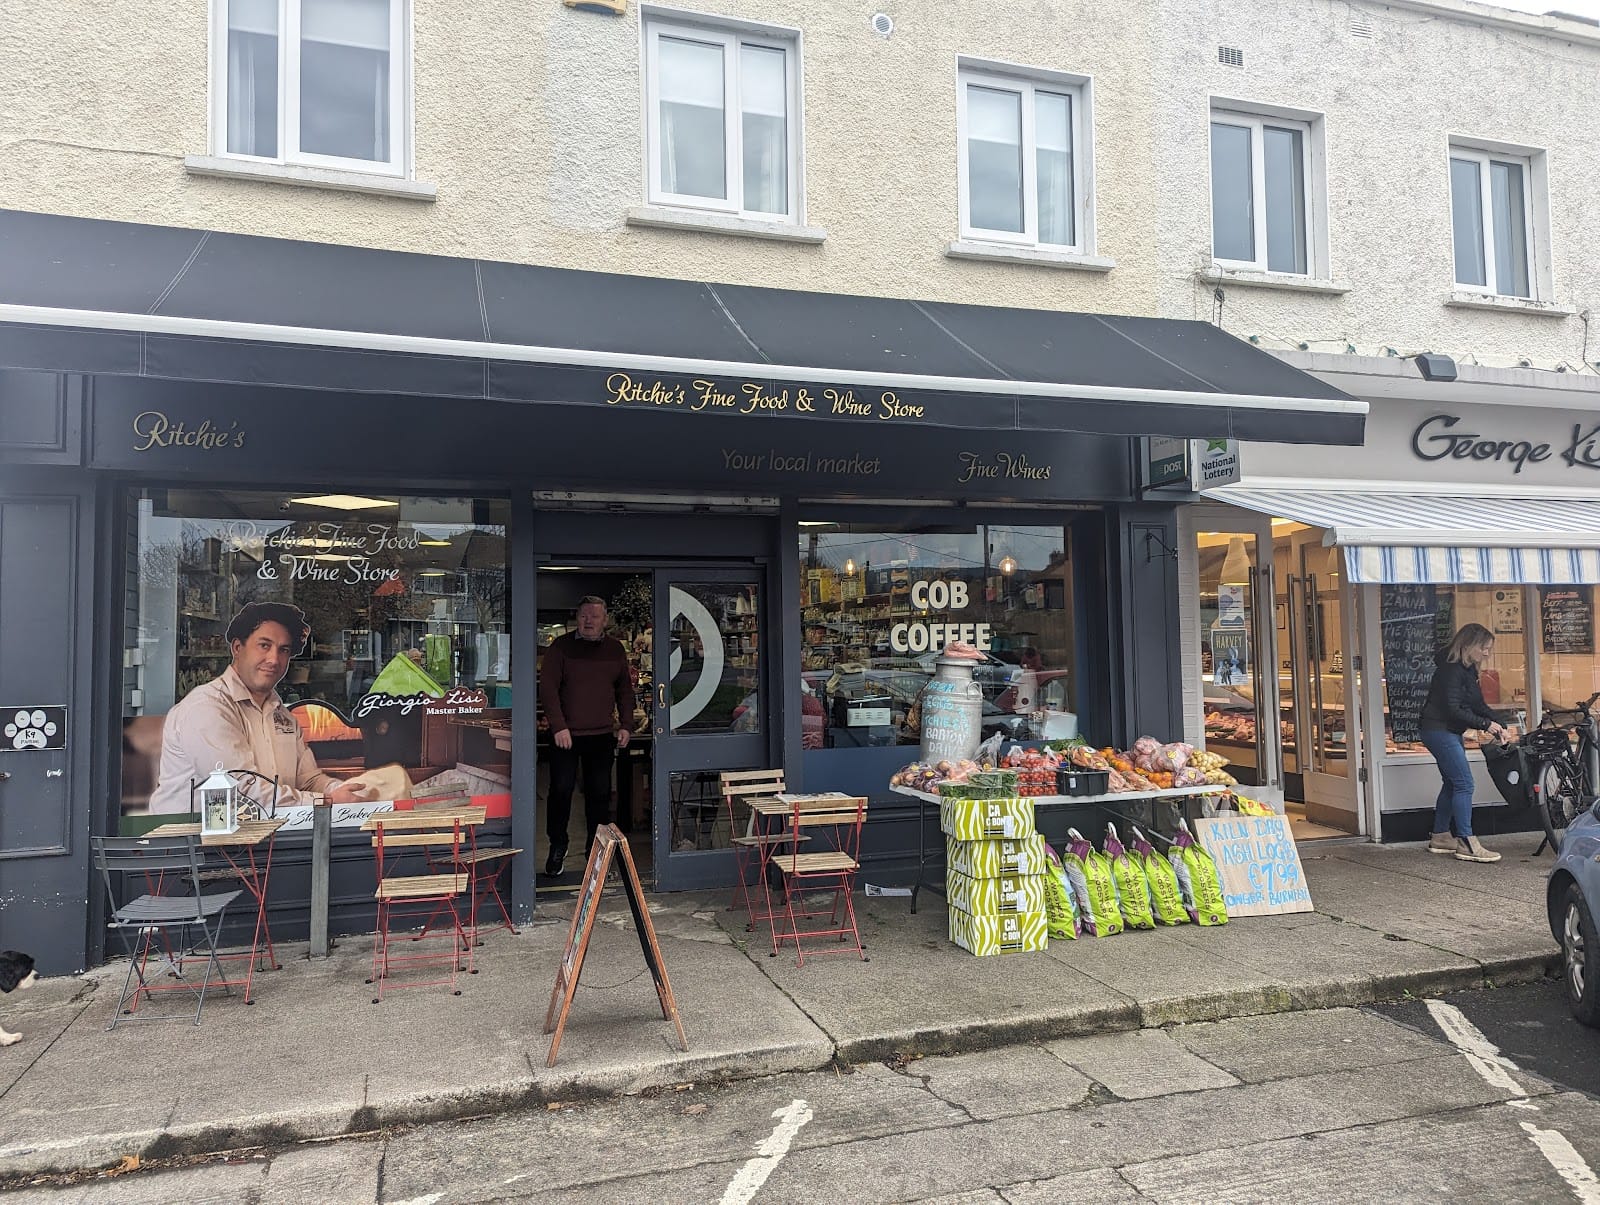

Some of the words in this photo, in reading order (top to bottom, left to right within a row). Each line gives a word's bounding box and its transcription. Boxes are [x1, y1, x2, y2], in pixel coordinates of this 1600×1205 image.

[606, 373, 685, 404] Ritchie's
[691, 379, 736, 411] Fine
[739, 383, 788, 414] Food
[795, 388, 816, 412] &
[823, 389, 872, 416] Wine
[879, 391, 924, 420] Store
[133, 411, 245, 451] Ritchie's
[1412, 414, 1552, 474] George
[721, 448, 766, 470] Your
[769, 449, 812, 472] local
[816, 452, 881, 474] market
[958, 451, 998, 482] Fine
[997, 452, 1051, 479] Wines
[1201, 454, 1236, 471] National
[1204, 466, 1234, 481] Lottery
[229, 520, 318, 552] Ritchie's
[315, 522, 367, 554] Fine
[364, 523, 420, 555] Food
[256, 559, 279, 580] &
[279, 553, 340, 581] Wine
[343, 555, 400, 585] Store
[911, 580, 969, 609] COB
[890, 623, 992, 652] COFFEE
[1215, 635, 1242, 649] HARVEY
[1384, 640, 1401, 650] AND
[357, 693, 436, 717] Giorgio
[446, 690, 483, 705] Lisi
[426, 707, 457, 715] Master
[458, 706, 483, 714] Baker
[25, 729, 36, 740] K9
[1210, 820, 1250, 841] KILN
[1222, 842, 1255, 865] ASH
[1256, 839, 1296, 862] LOGS
[1224, 891, 1265, 908] ONGER
